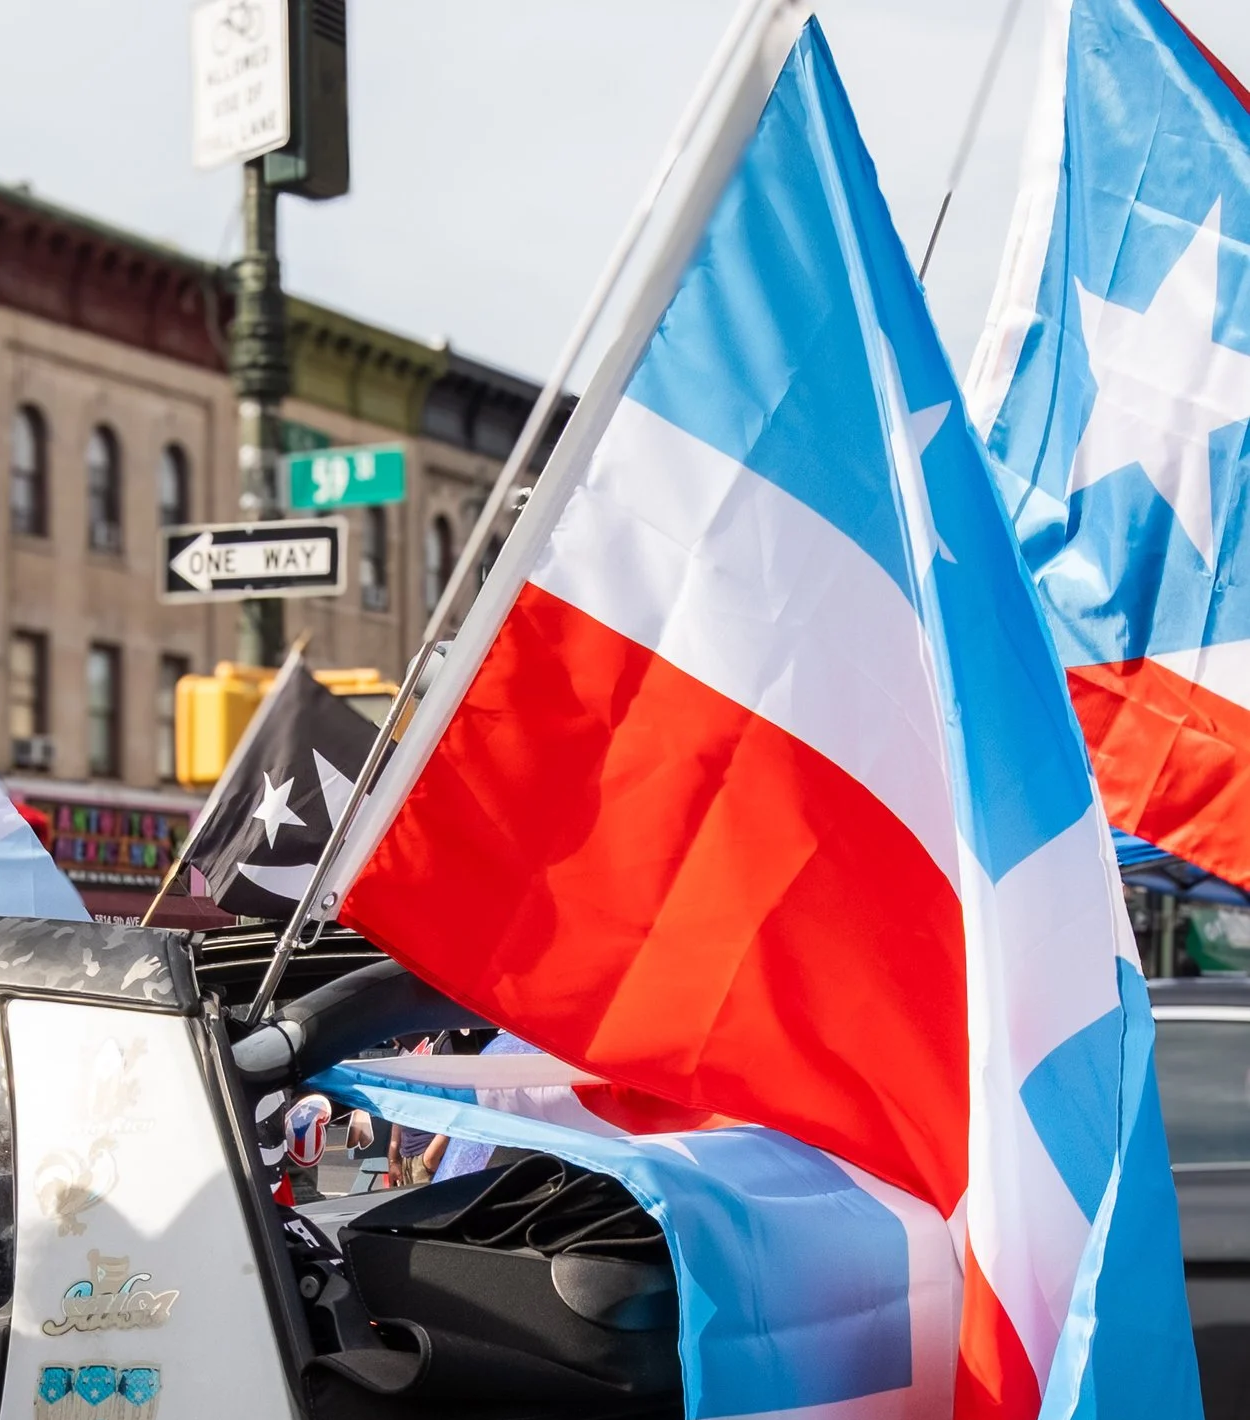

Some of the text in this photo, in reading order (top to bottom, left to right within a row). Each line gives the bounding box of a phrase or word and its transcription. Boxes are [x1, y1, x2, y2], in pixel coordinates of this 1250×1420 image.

[311, 455, 350, 504] 59
[189, 544, 317, 576] ONE WAY
[126, 916, 141, 927] AVE
